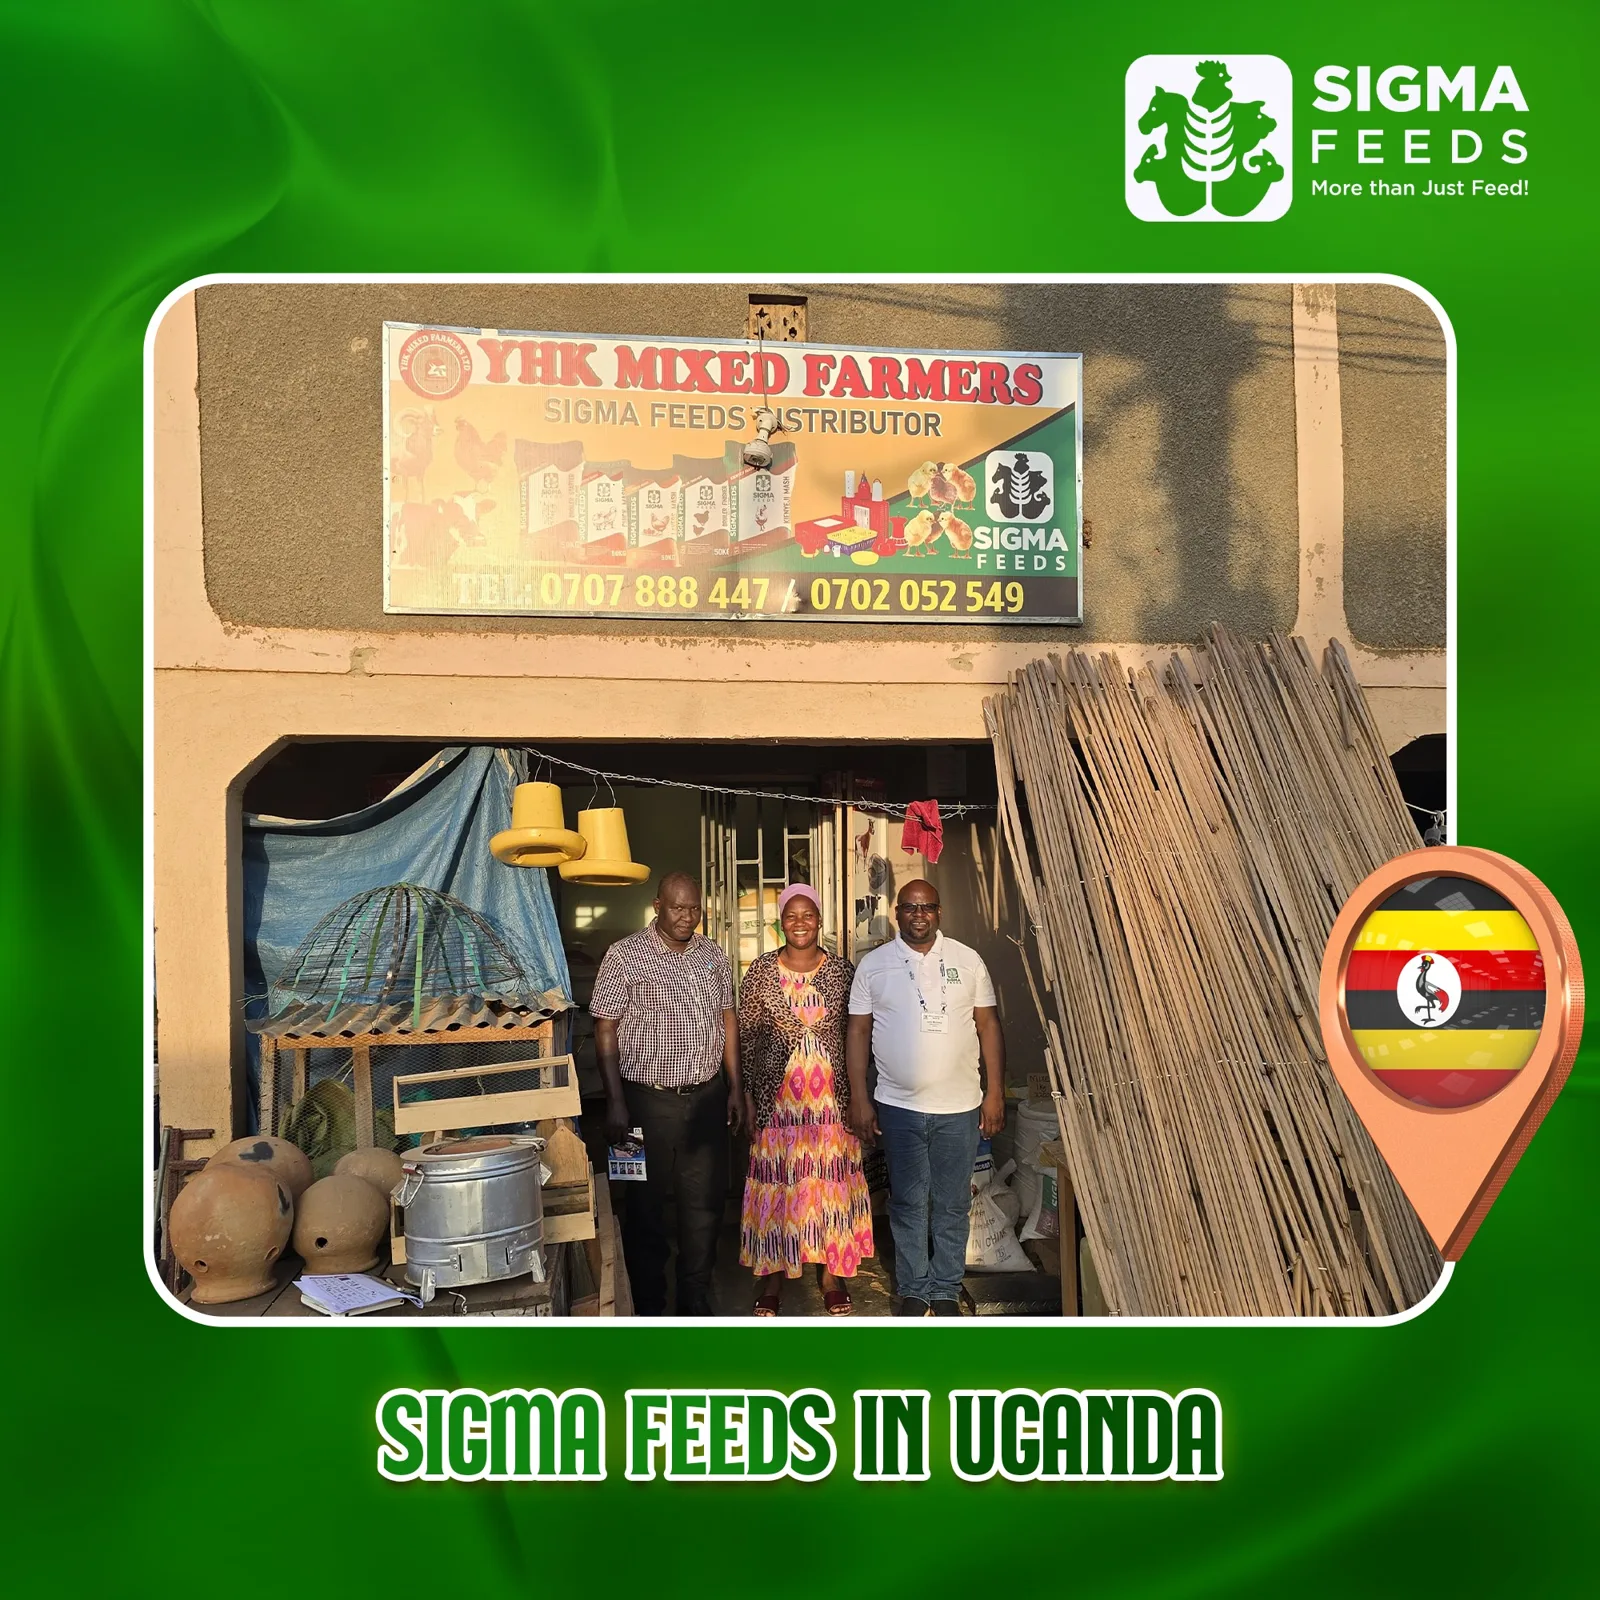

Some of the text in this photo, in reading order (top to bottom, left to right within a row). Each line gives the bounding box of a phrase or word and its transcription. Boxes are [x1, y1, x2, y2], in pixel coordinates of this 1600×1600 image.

[477, 339, 1044, 405] YHK MIXED FARMERS
[544, 397, 641, 427] SIGMA
[650, 402, 746, 430] FEEDS
[973, 527, 1069, 552] SIGMA
[977, 554, 1067, 571] FEEDS
[452, 572, 532, 605] TEL:
[540, 573, 624, 606] 0707
[635, 575, 699, 607] 888
[708, 577, 770, 609] 447
[811, 578, 890, 611] 0702
[899, 580, 957, 611] 052
[966, 581, 1024, 613] 549
